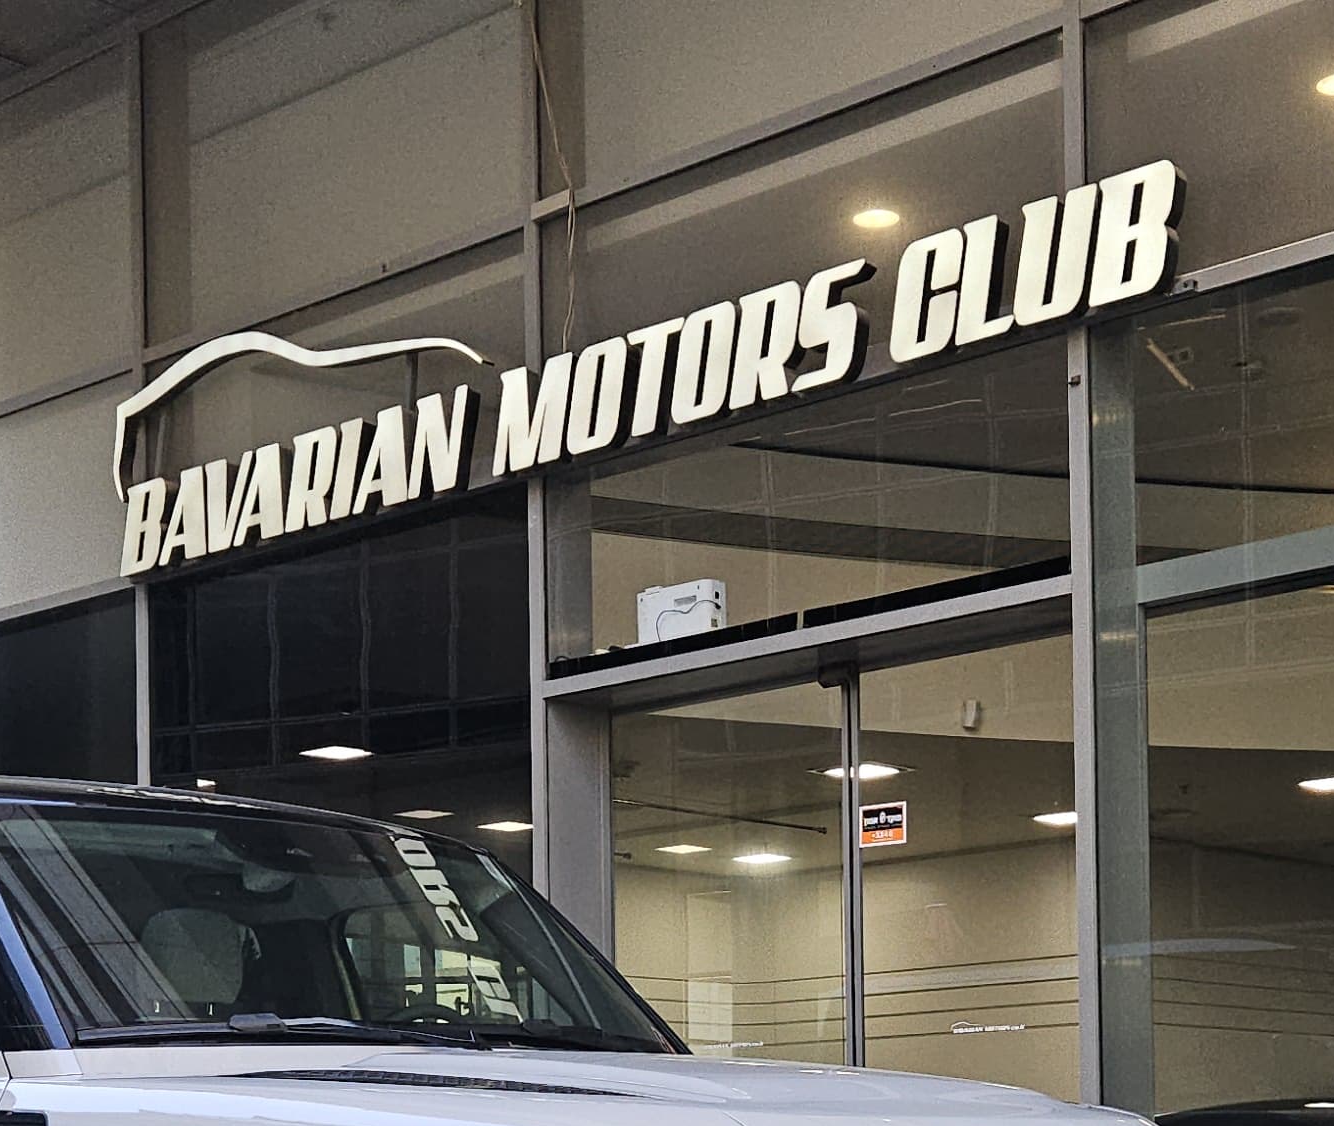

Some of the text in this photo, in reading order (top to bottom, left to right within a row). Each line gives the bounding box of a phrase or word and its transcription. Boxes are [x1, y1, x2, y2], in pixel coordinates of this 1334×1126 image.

[120, 159, 1184, 579] BAVARIAN MOTORS CLUB
